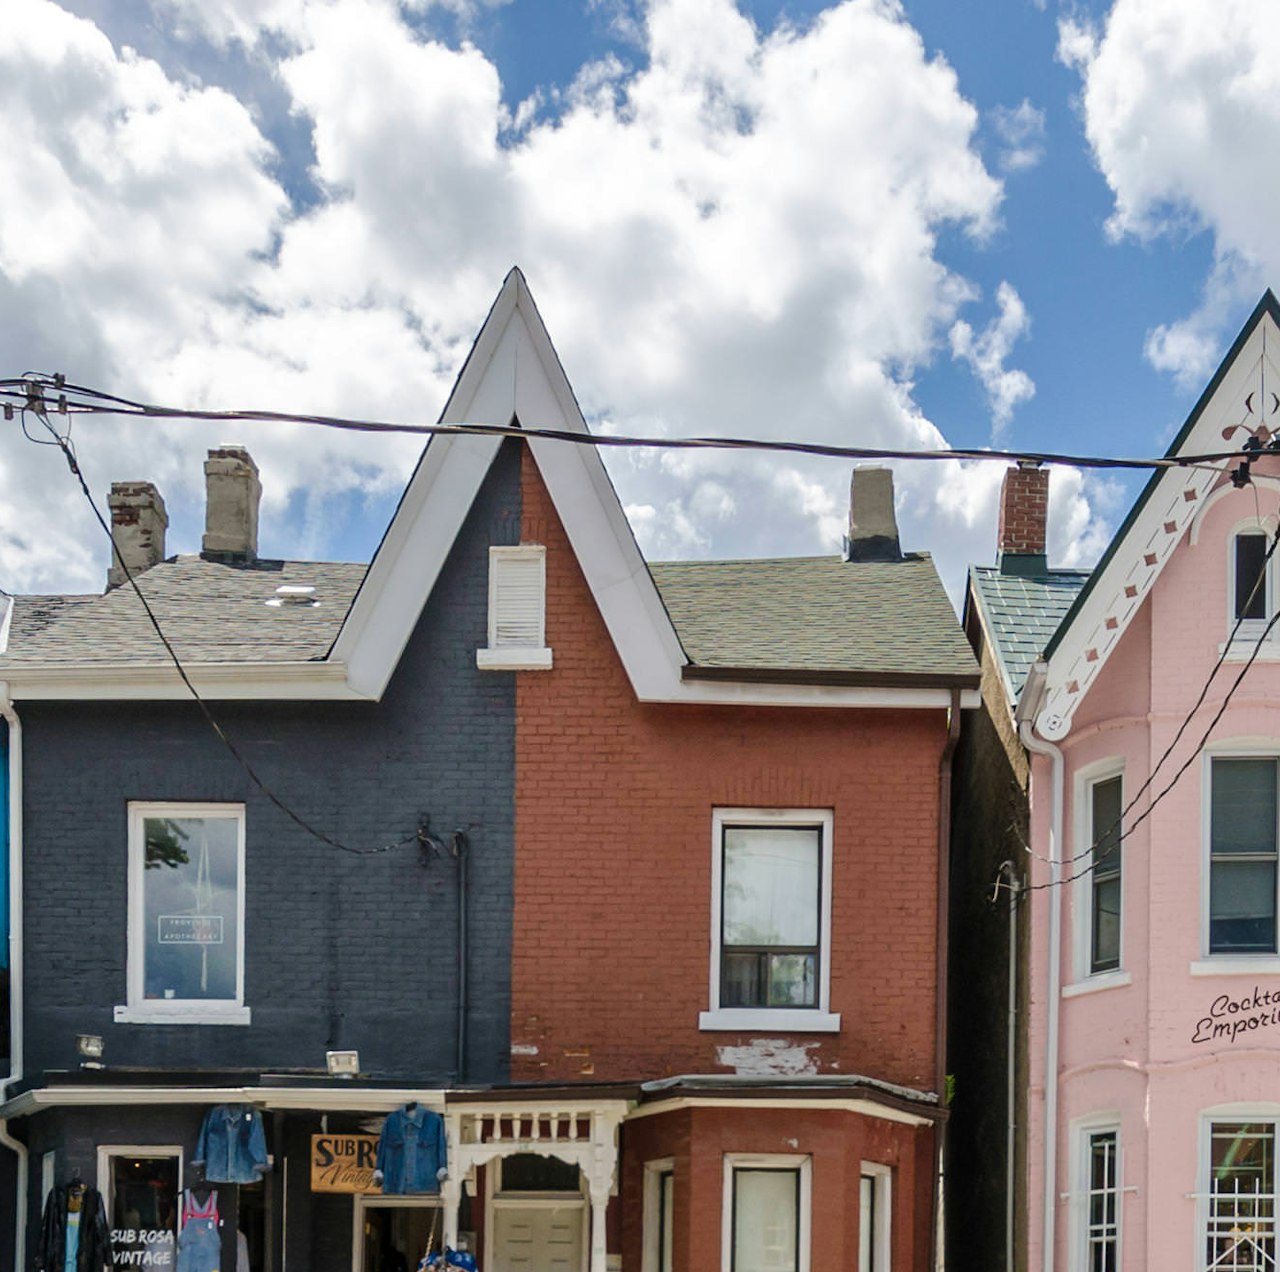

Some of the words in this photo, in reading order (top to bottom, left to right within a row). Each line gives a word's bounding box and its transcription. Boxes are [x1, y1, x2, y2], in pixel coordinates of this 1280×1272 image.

[110, 1228, 137, 1244] SUB
[138, 1229, 175, 1245] ROSA
[112, 1250, 172, 1266] VINTAGE
